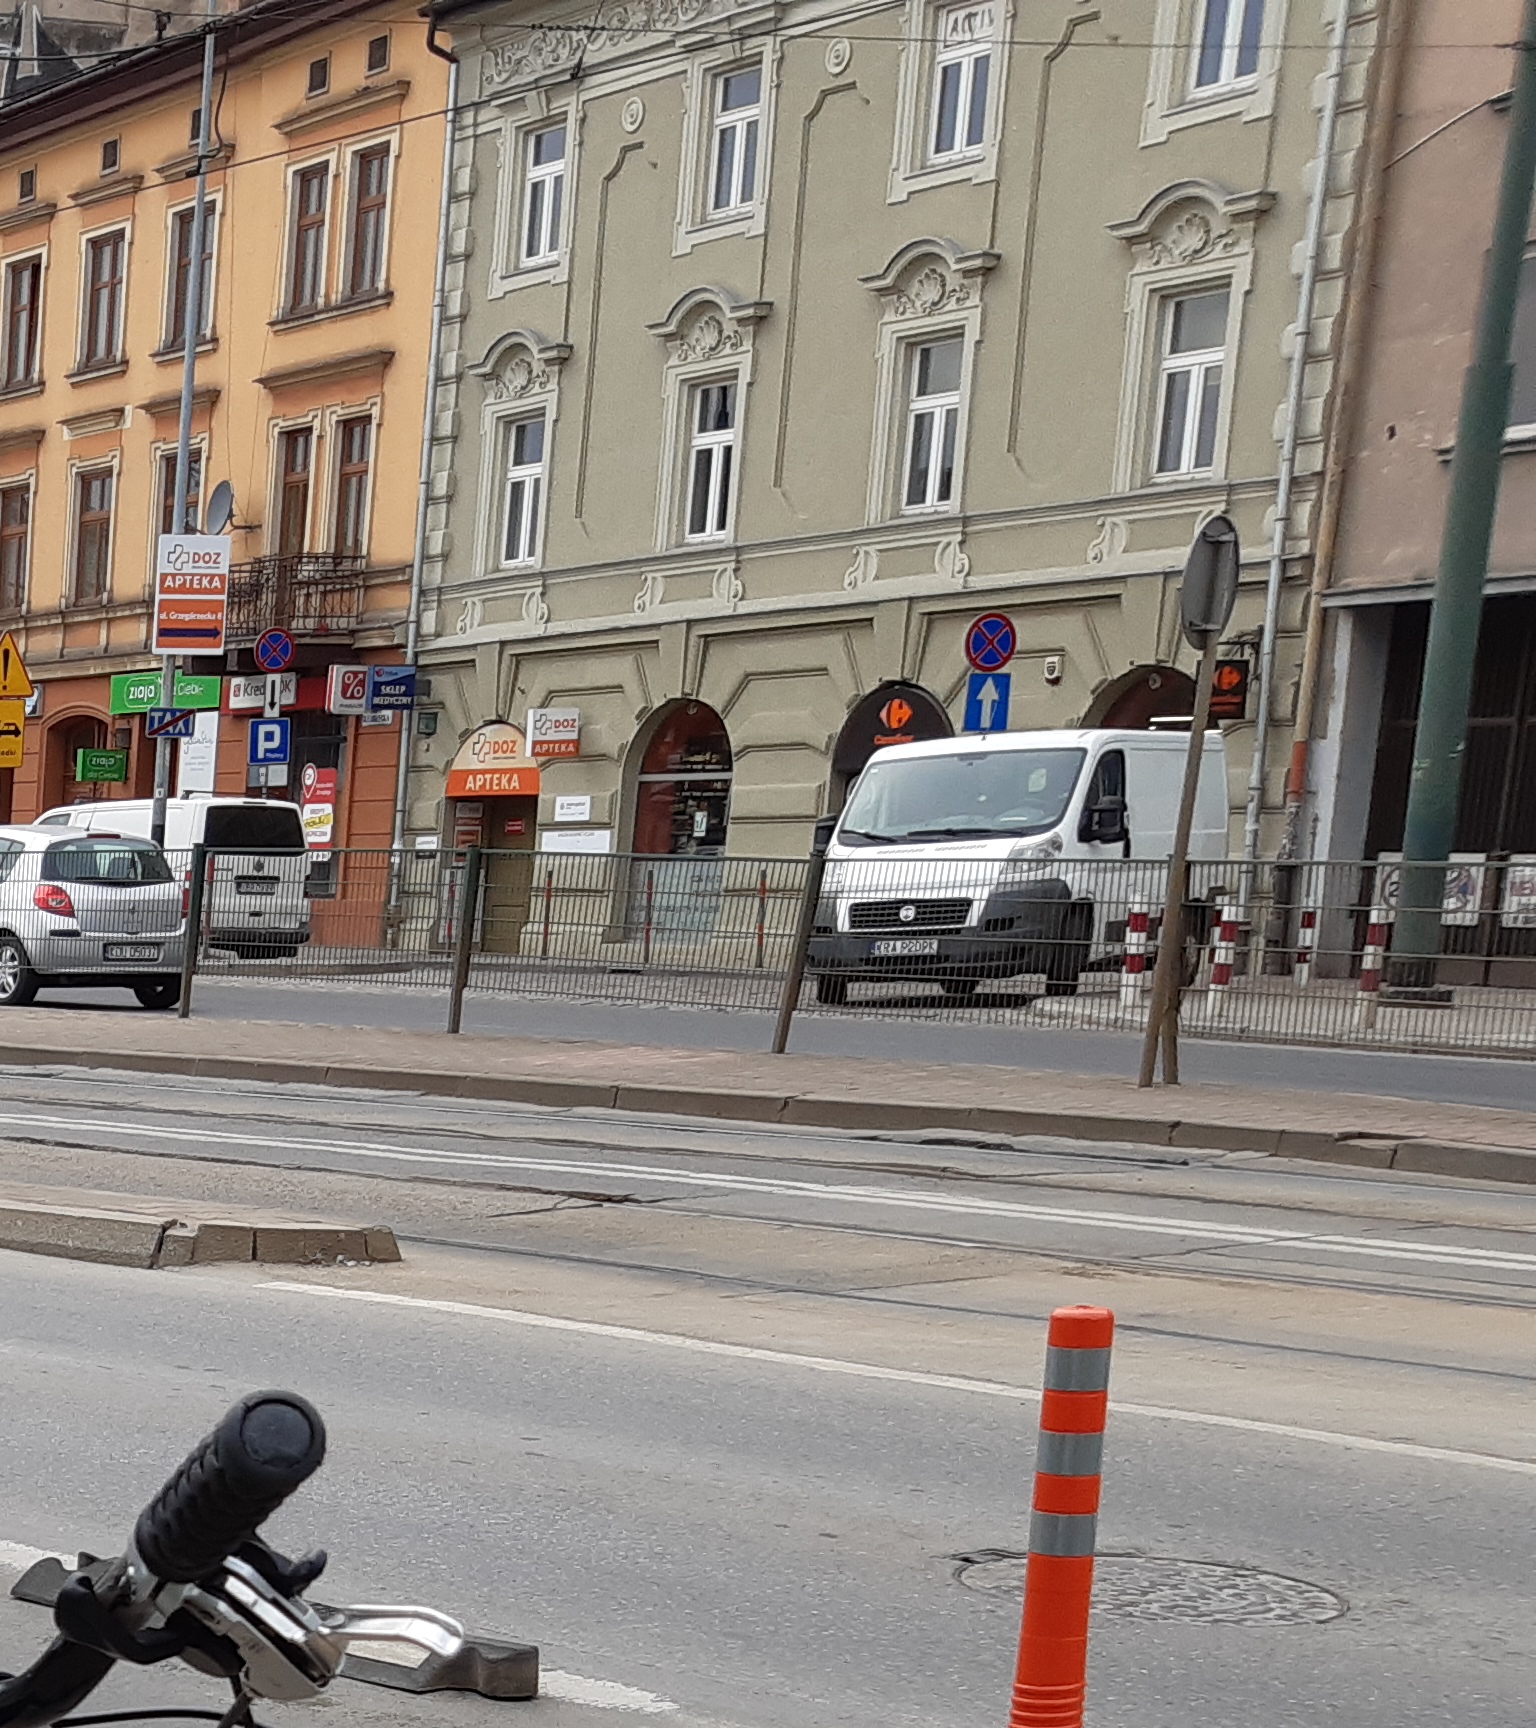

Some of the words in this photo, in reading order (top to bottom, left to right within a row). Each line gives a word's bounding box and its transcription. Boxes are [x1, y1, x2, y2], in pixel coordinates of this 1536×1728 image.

[191, 552, 222, 565] DOZ
[163, 575, 222, 589] APTEKA
[150, 711, 194, 734] TAXI
[554, 718, 577, 729] DOZ
[258, 724, 281, 759] P
[492, 740, 518, 755] DOZ
[534, 743, 576, 753] APTEKA
[465, 773, 520, 791] APTEKA
